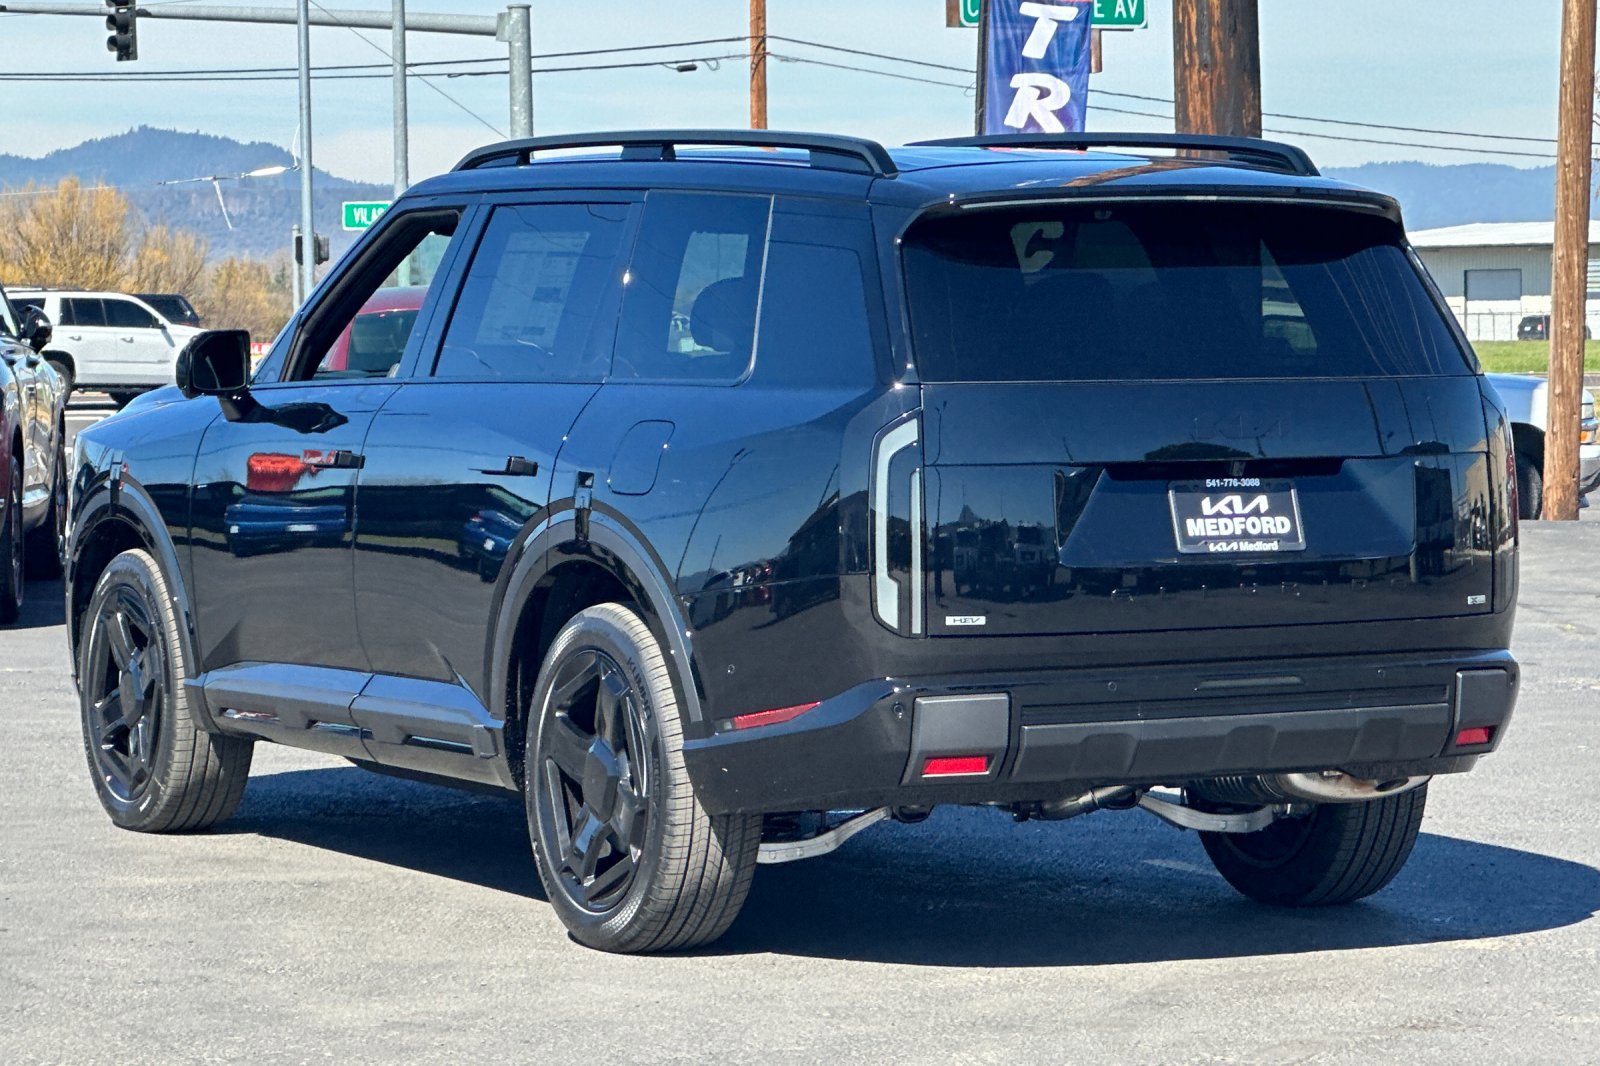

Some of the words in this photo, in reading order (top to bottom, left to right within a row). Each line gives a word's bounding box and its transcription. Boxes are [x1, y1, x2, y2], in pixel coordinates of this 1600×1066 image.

[1201, 494, 1269, 516] KIA
[1186, 516, 1291, 537] MEDFORD
[1208, 541, 1238, 552] KIA
[1239, 540, 1279, 551] Medford
